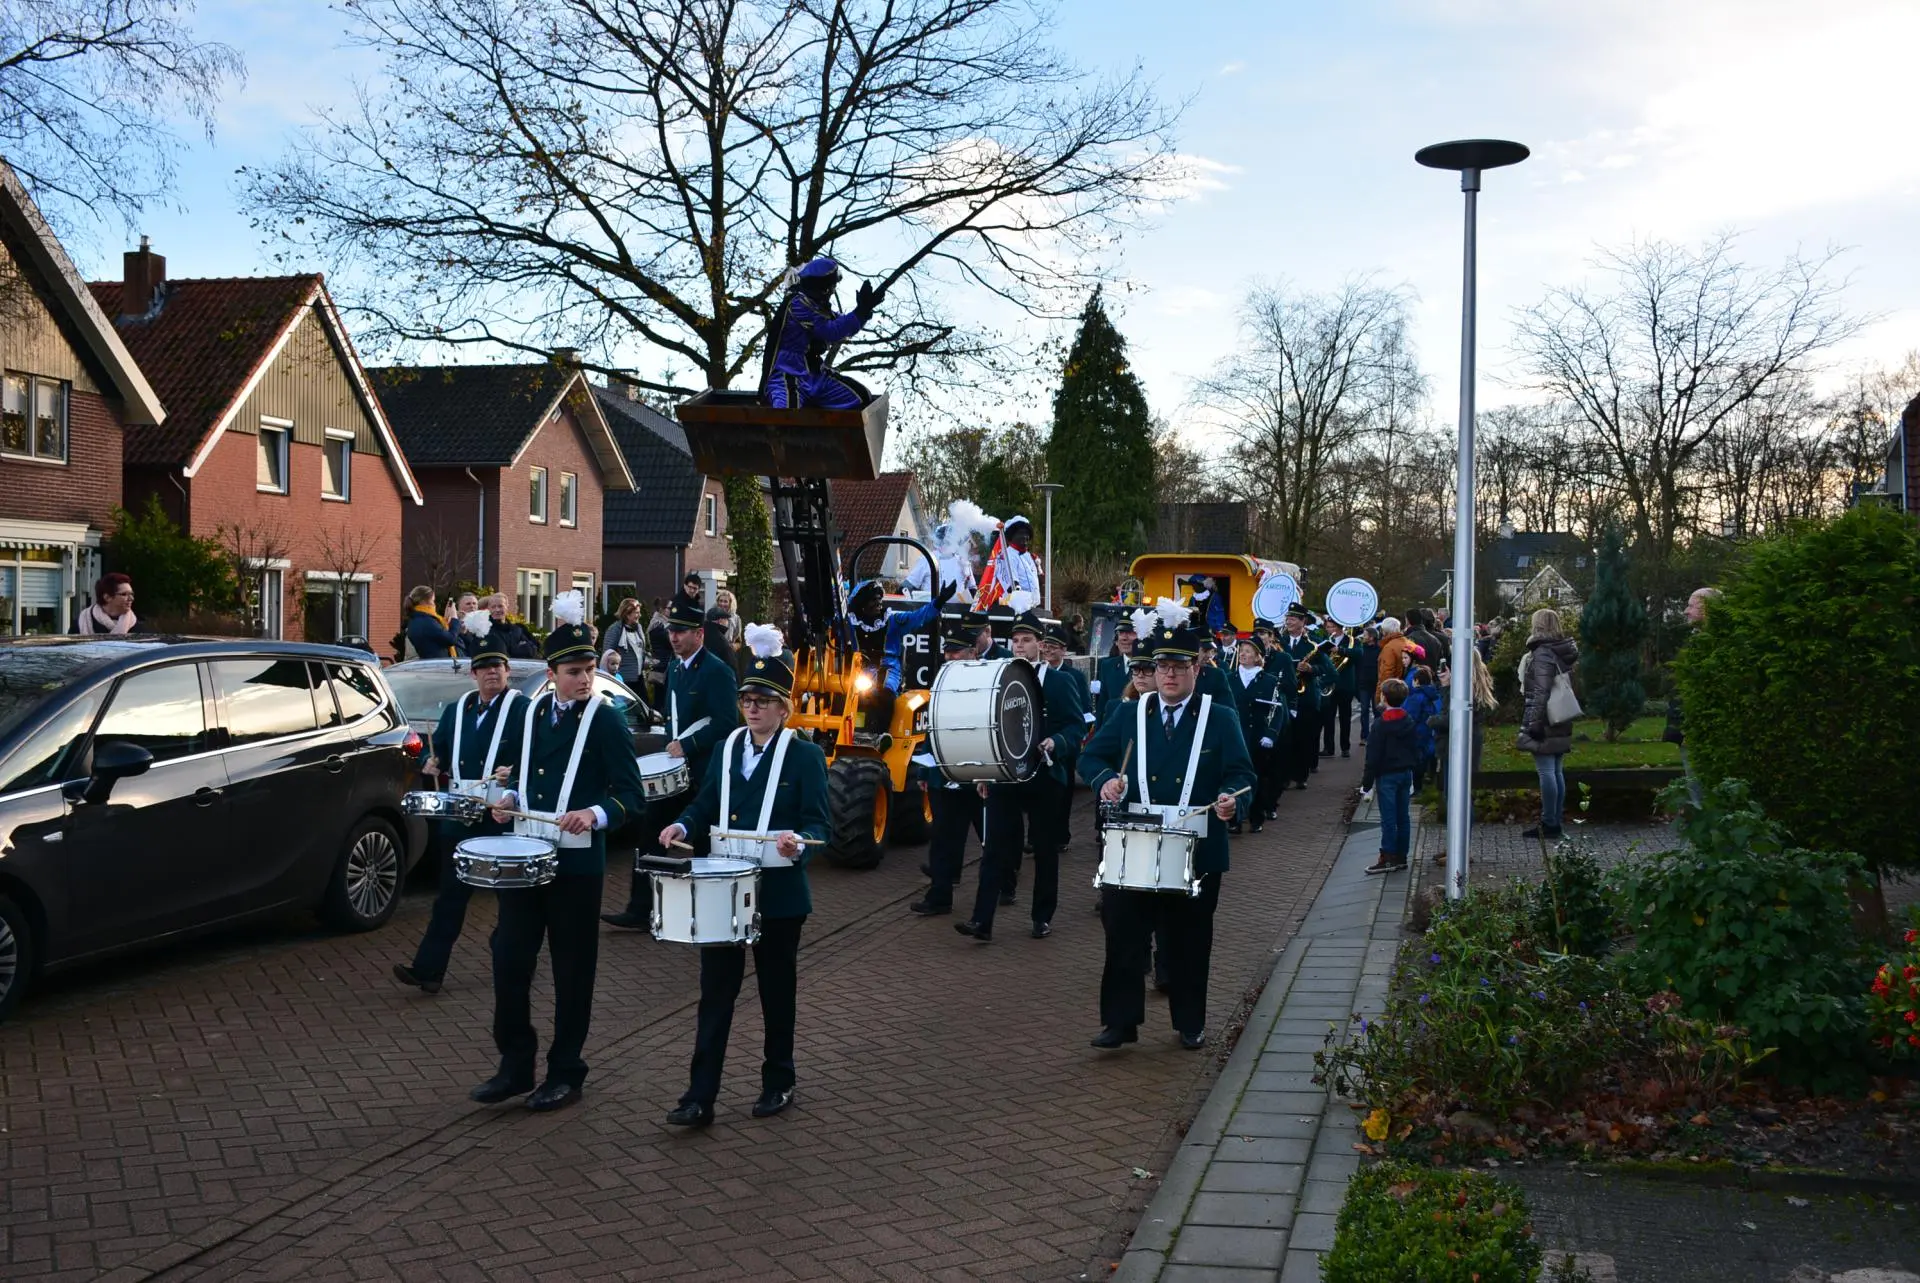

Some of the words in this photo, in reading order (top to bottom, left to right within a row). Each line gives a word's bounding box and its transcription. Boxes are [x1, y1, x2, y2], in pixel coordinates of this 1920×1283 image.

[1336, 590, 1369, 598] AMICITIA
[1003, 696, 1027, 711] AMICITIA
[916, 711, 929, 731] JC
